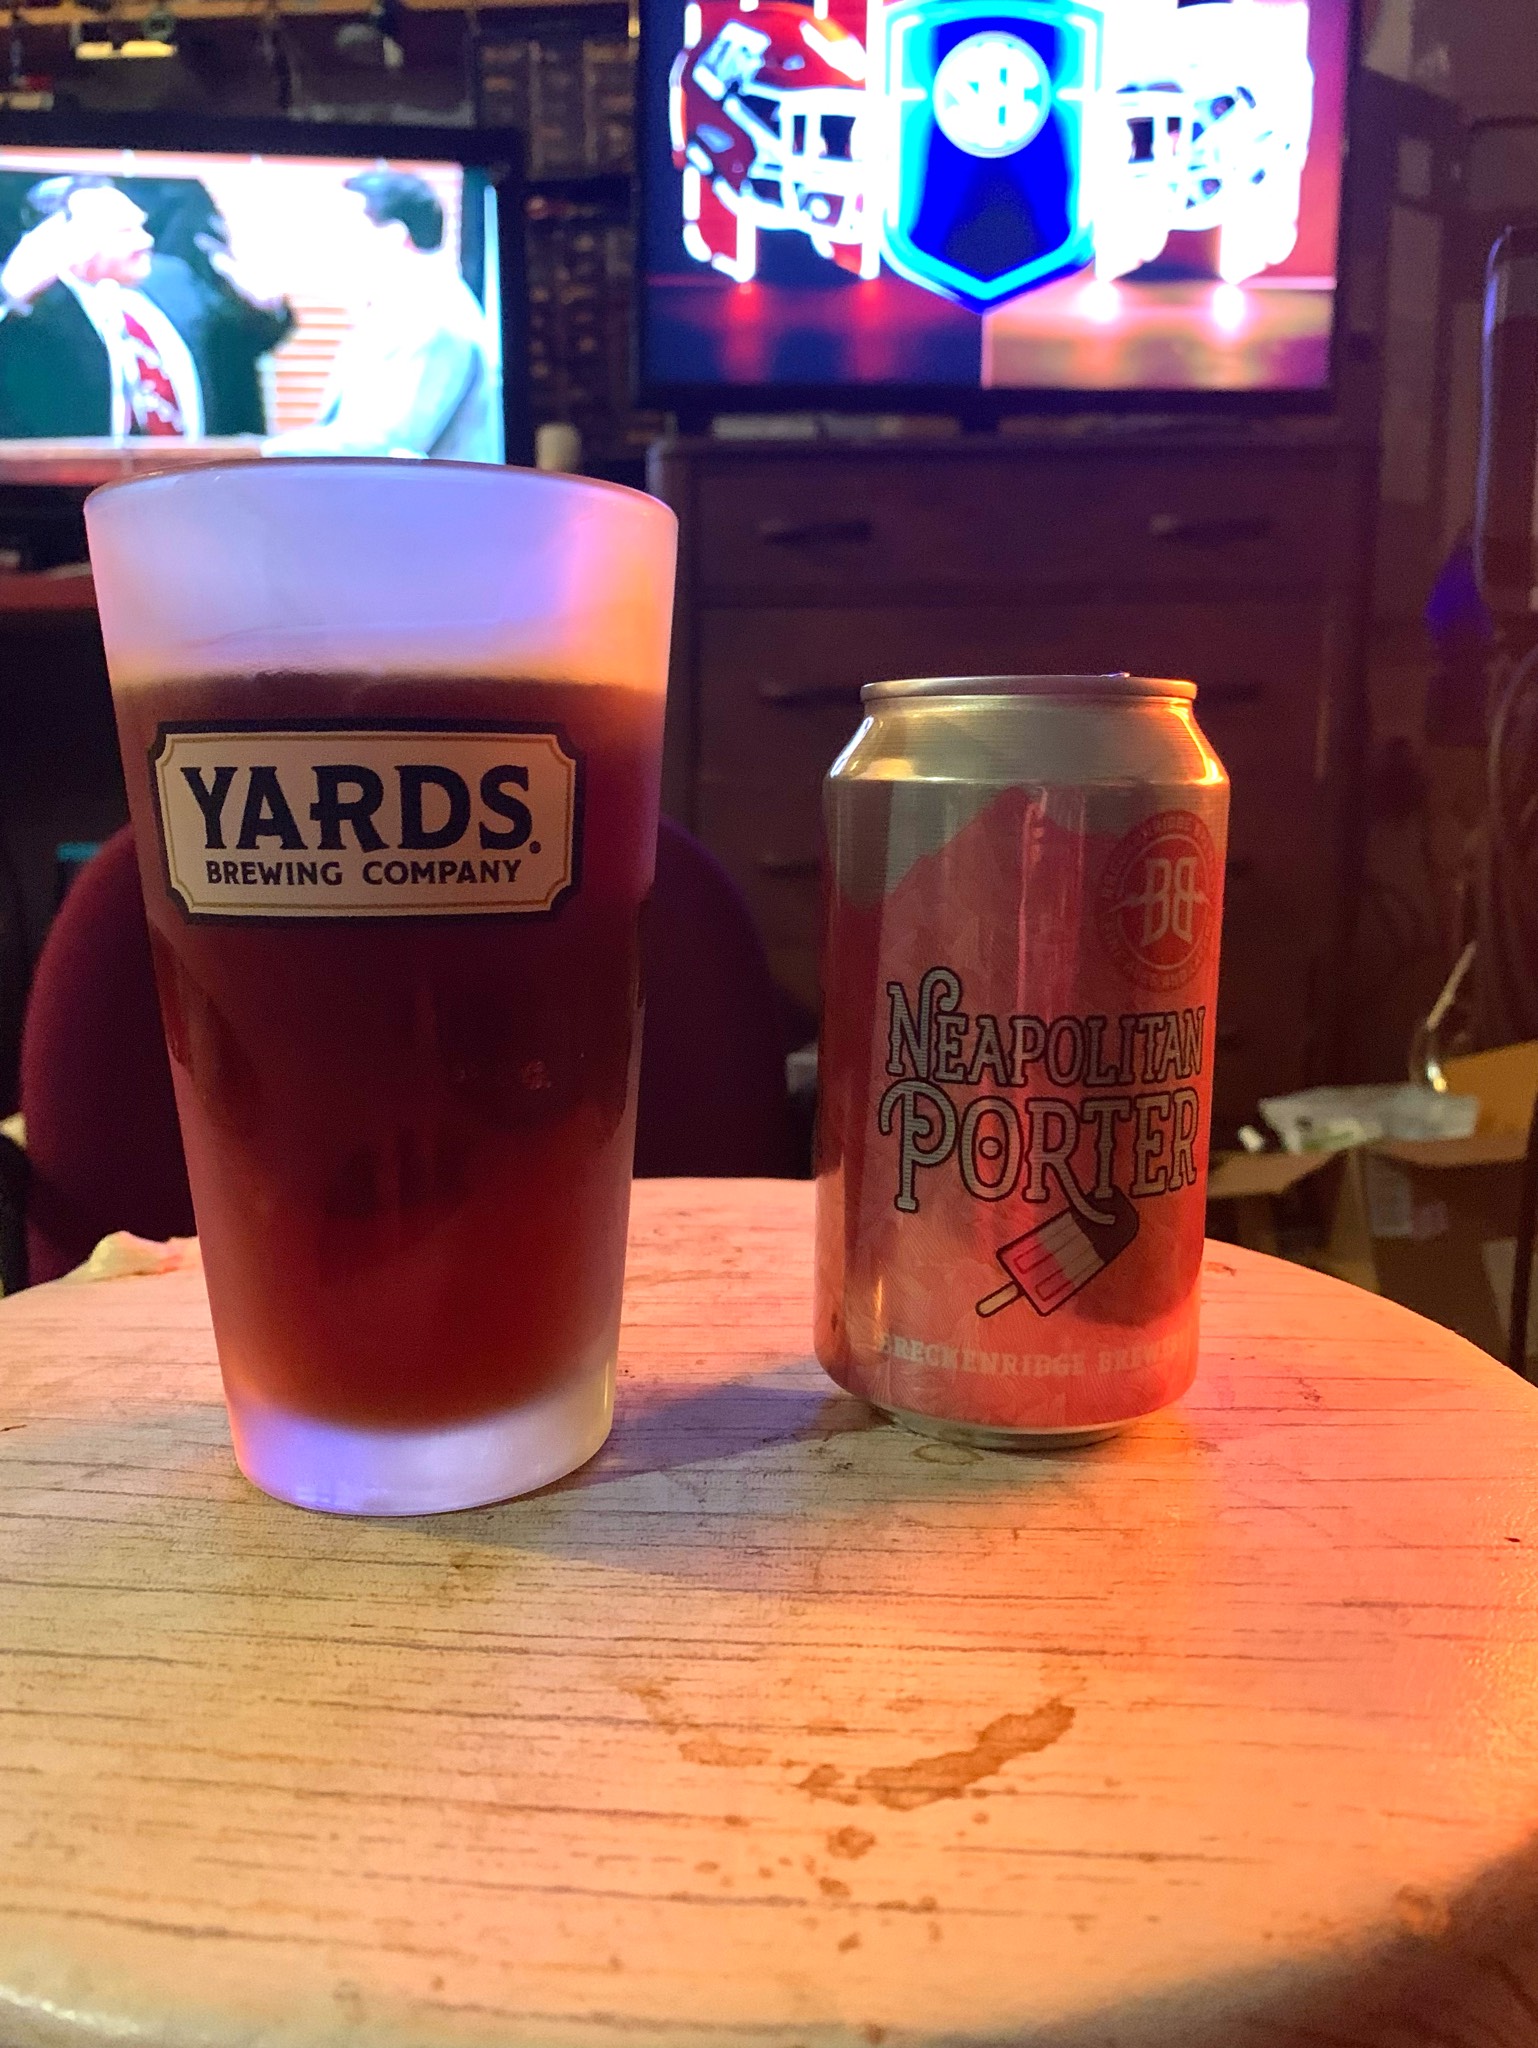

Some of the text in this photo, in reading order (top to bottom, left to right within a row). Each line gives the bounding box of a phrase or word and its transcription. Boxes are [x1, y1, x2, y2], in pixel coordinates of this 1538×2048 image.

[180, 765, 542, 853] YARDS.
[206, 859, 522, 886] BREWING COMPANY
[886, 966, 1206, 1088] NEAPOLITAN
[878, 1077, 1200, 1226] PORTER
